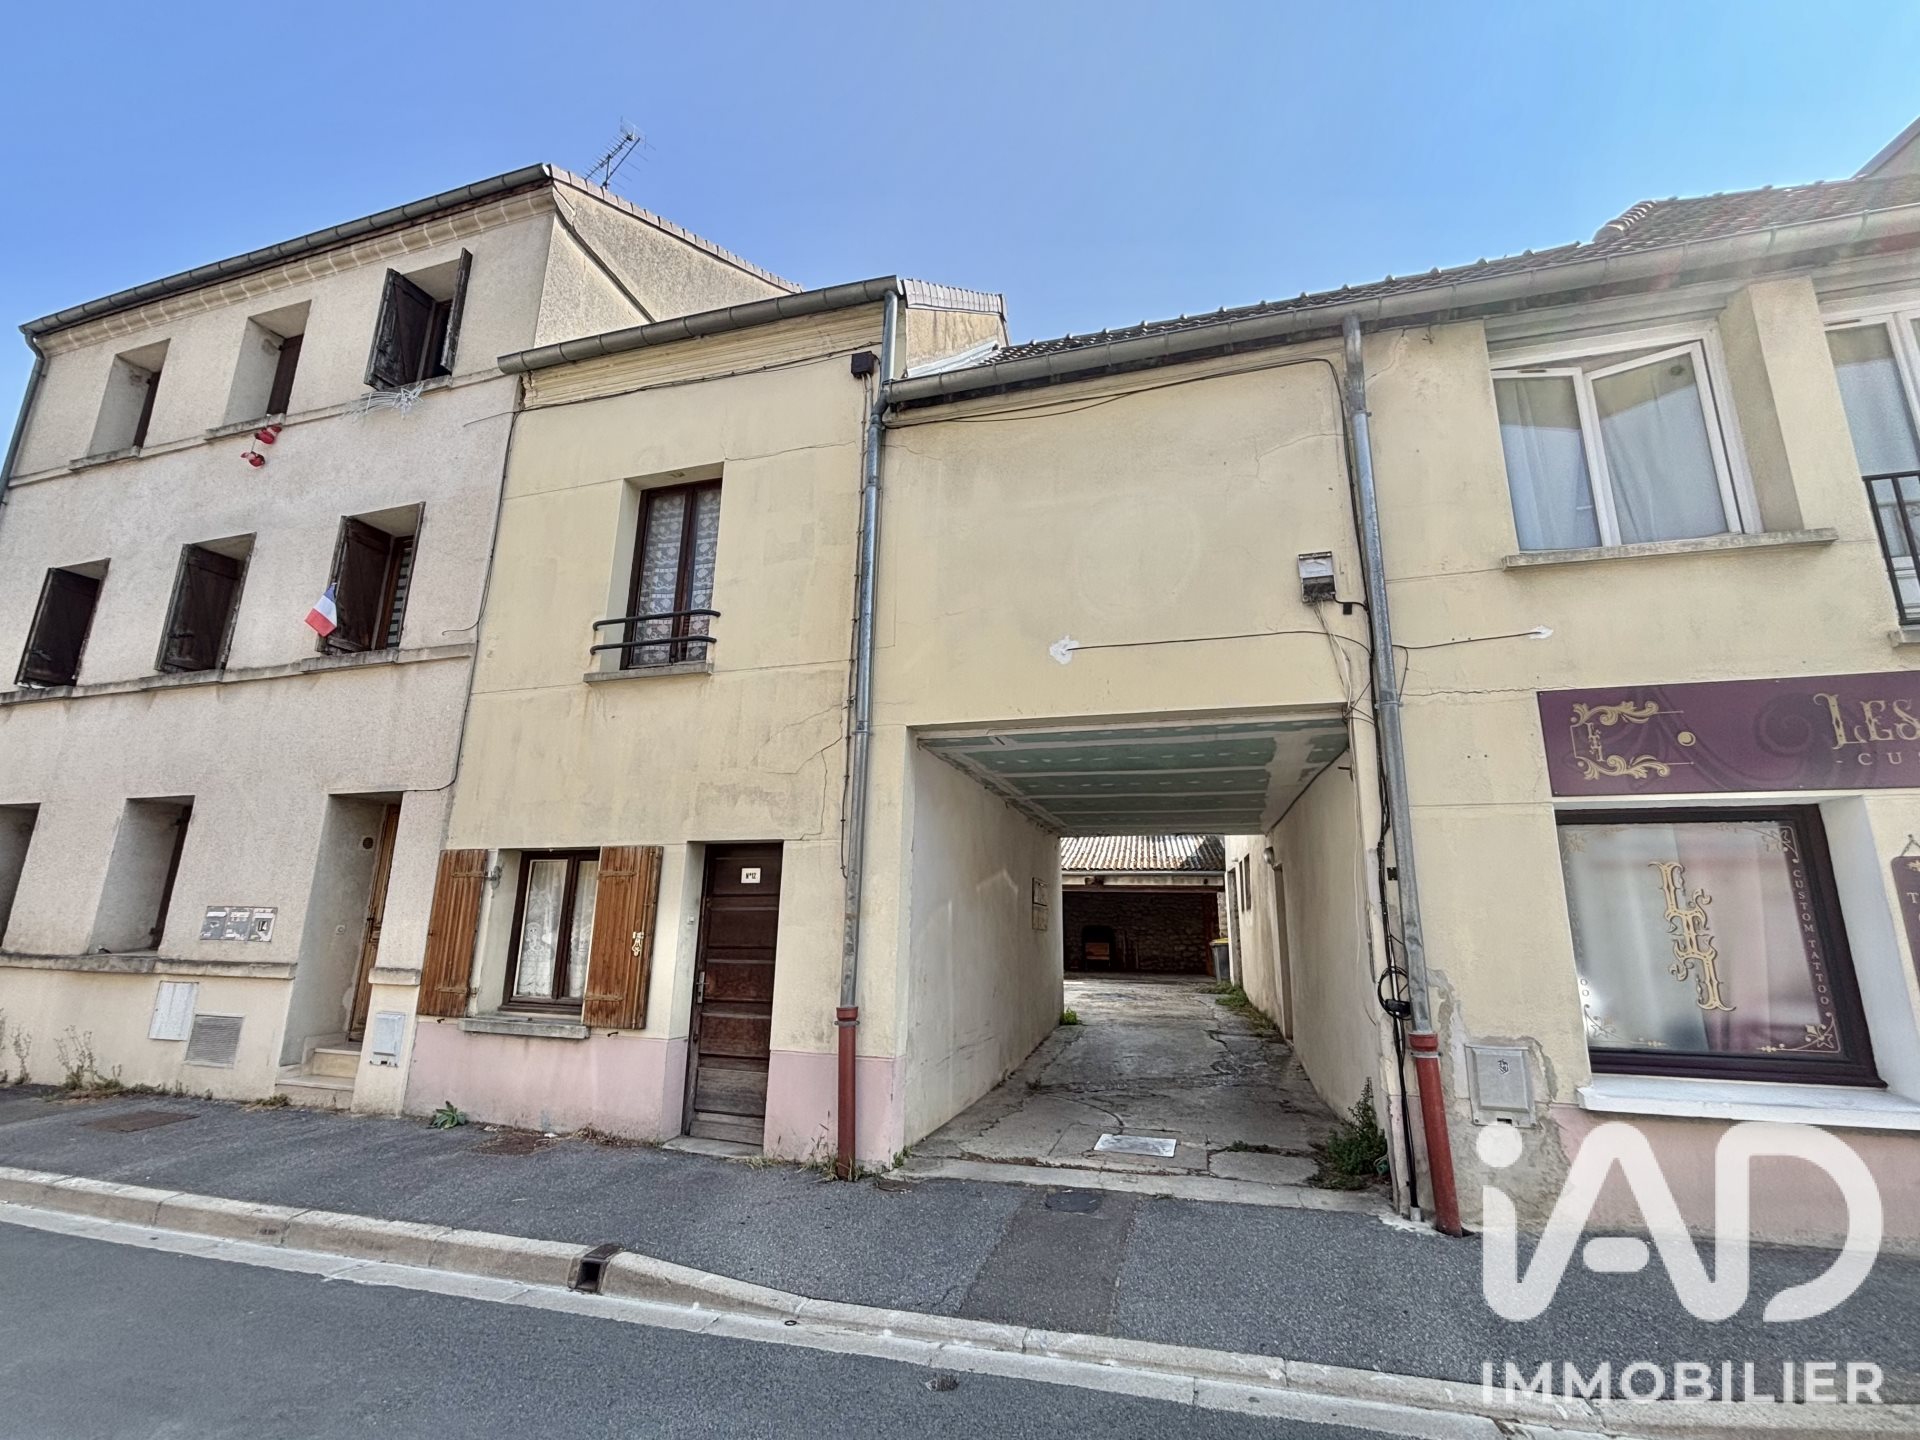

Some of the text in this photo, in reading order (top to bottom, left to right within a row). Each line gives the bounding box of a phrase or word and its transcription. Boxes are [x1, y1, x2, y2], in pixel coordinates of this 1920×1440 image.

[1857, 752, 1920, 766] CU
[1793, 869, 1829, 1005] CUSTOM TATTOO
